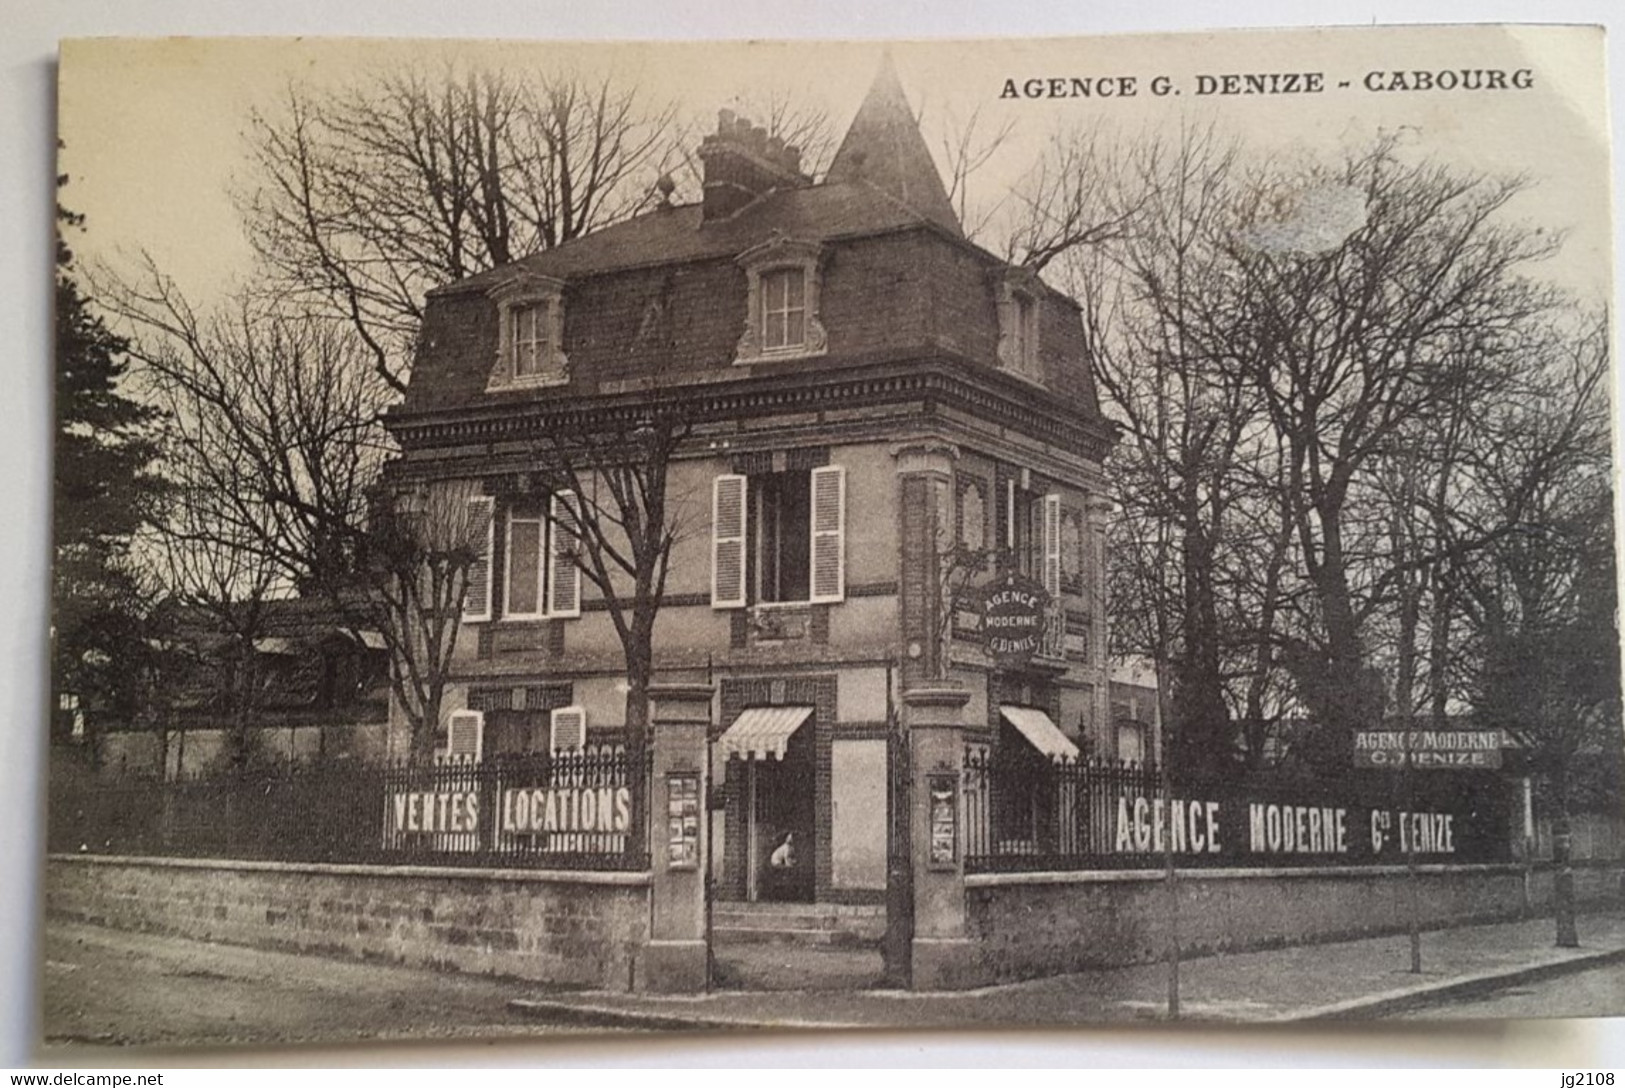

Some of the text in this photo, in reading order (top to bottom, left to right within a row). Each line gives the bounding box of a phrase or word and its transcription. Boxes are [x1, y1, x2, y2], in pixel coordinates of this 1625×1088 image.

[984, 590, 1038, 611] AGENCE
[985, 614, 1038, 628] MODERNE
[1423, 731, 1499, 750] MODERNE
[394, 792, 478, 832] VENTES
[503, 787, 630, 832] LOCATIONS
[1115, 796, 1222, 853] AGENCE
[1250, 803, 1348, 853] MODERNE
